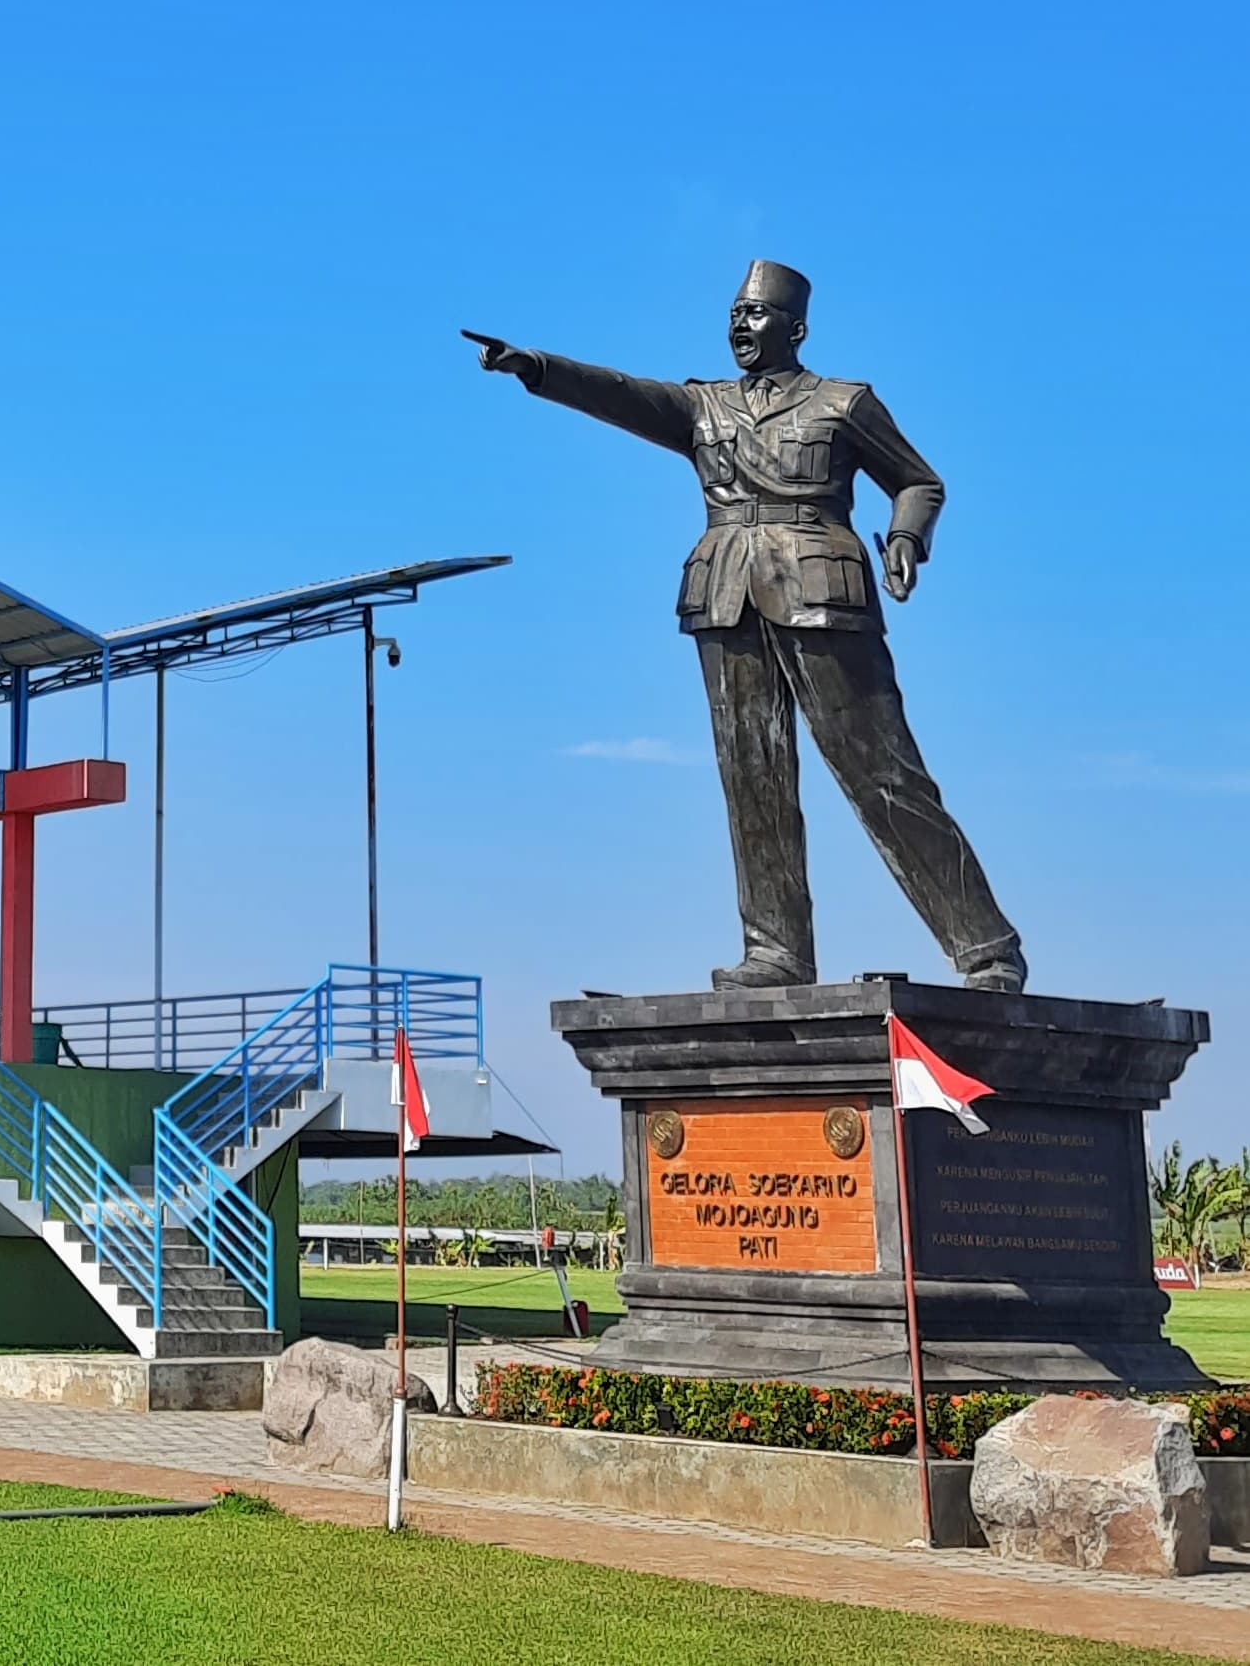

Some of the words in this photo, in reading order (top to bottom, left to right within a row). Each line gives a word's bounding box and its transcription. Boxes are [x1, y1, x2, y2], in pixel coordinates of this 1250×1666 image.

[946, 1126, 1028, 1143] PERNGANKU
[937, 1165, 978, 1179] KARENA
[661, 1173, 737, 1196] GELORA
[749, 1173, 858, 1198] SOEKARNO
[696, 1204, 820, 1229] MOJOAGUNG
[940, 1200, 1022, 1216] PERJUANGANMU
[739, 1236, 779, 1259] PATI
[932, 1233, 974, 1247] KARENA
[975, 1235, 1025, 1249] MELAWAN
[1027, 1238, 1082, 1252] BANGSAMU
